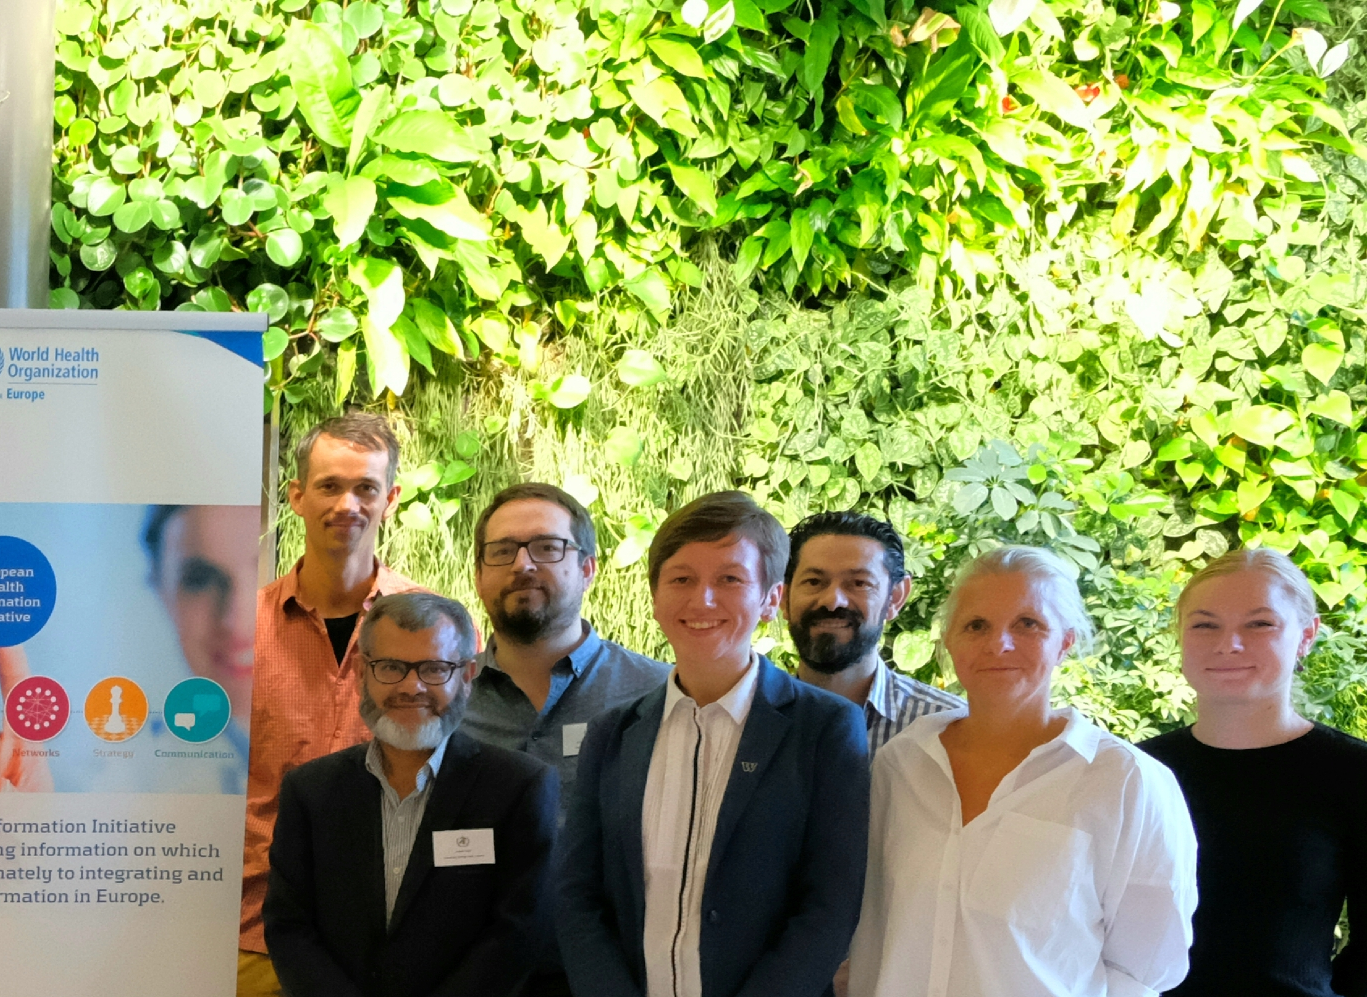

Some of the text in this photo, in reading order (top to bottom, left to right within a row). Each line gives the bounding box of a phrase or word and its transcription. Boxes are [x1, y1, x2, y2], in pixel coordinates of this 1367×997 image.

[9, 347, 99, 362] World Health
[8, 364, 98, 381] Organization
[7, 388, 45, 402] Europe
[12, 748, 60, 758] Networks
[92, 748, 134, 759] Strategy
[154, 749, 235, 759] Communication
[92, 819, 176, 834] Initiative
[20, 842, 128, 857] information
[133, 845, 156, 857] on
[161, 843, 220, 858] which
[57, 867, 75, 880] to
[79, 865, 183, 884] integrating
[187, 867, 223, 881] and
[74, 889, 90, 903] in
[96, 889, 165, 907] Europe.
